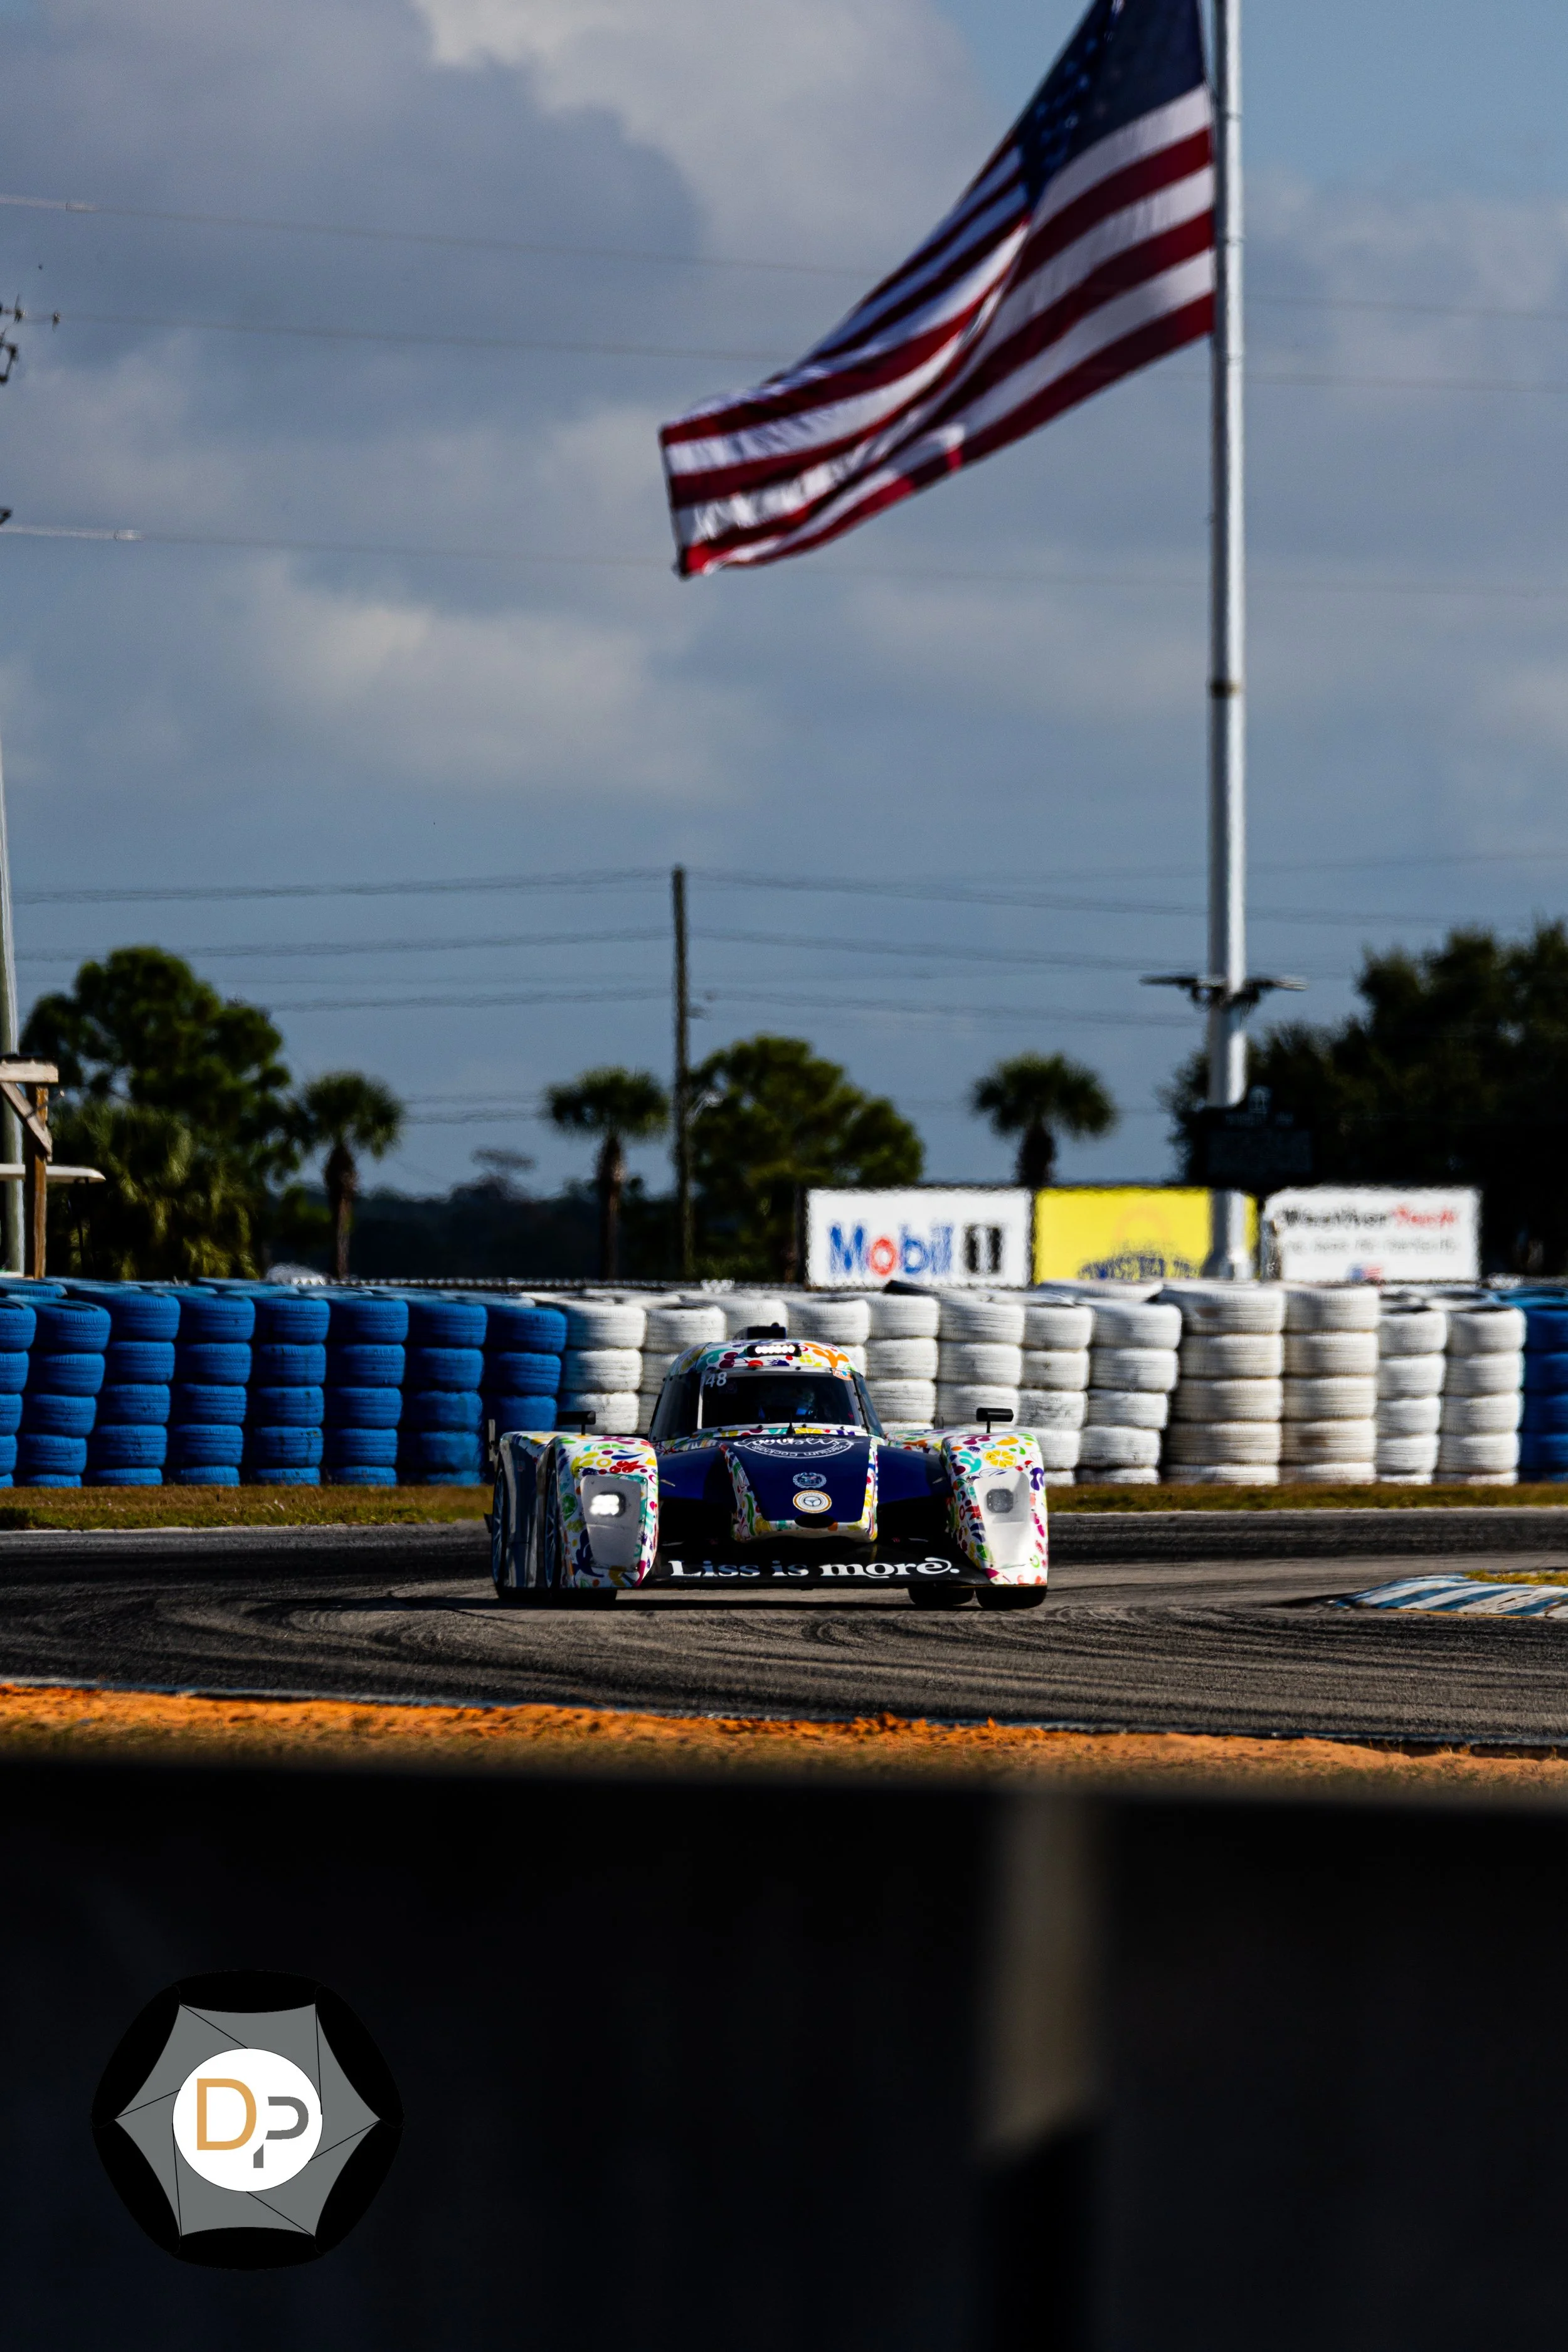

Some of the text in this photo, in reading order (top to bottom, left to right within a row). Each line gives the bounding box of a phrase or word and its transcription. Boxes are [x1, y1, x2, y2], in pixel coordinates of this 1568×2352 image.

[829, 1222, 954, 1276] Mobil
[705, 1372, 727, 1387] 48
[668, 1557, 960, 1579] Liss is more.
